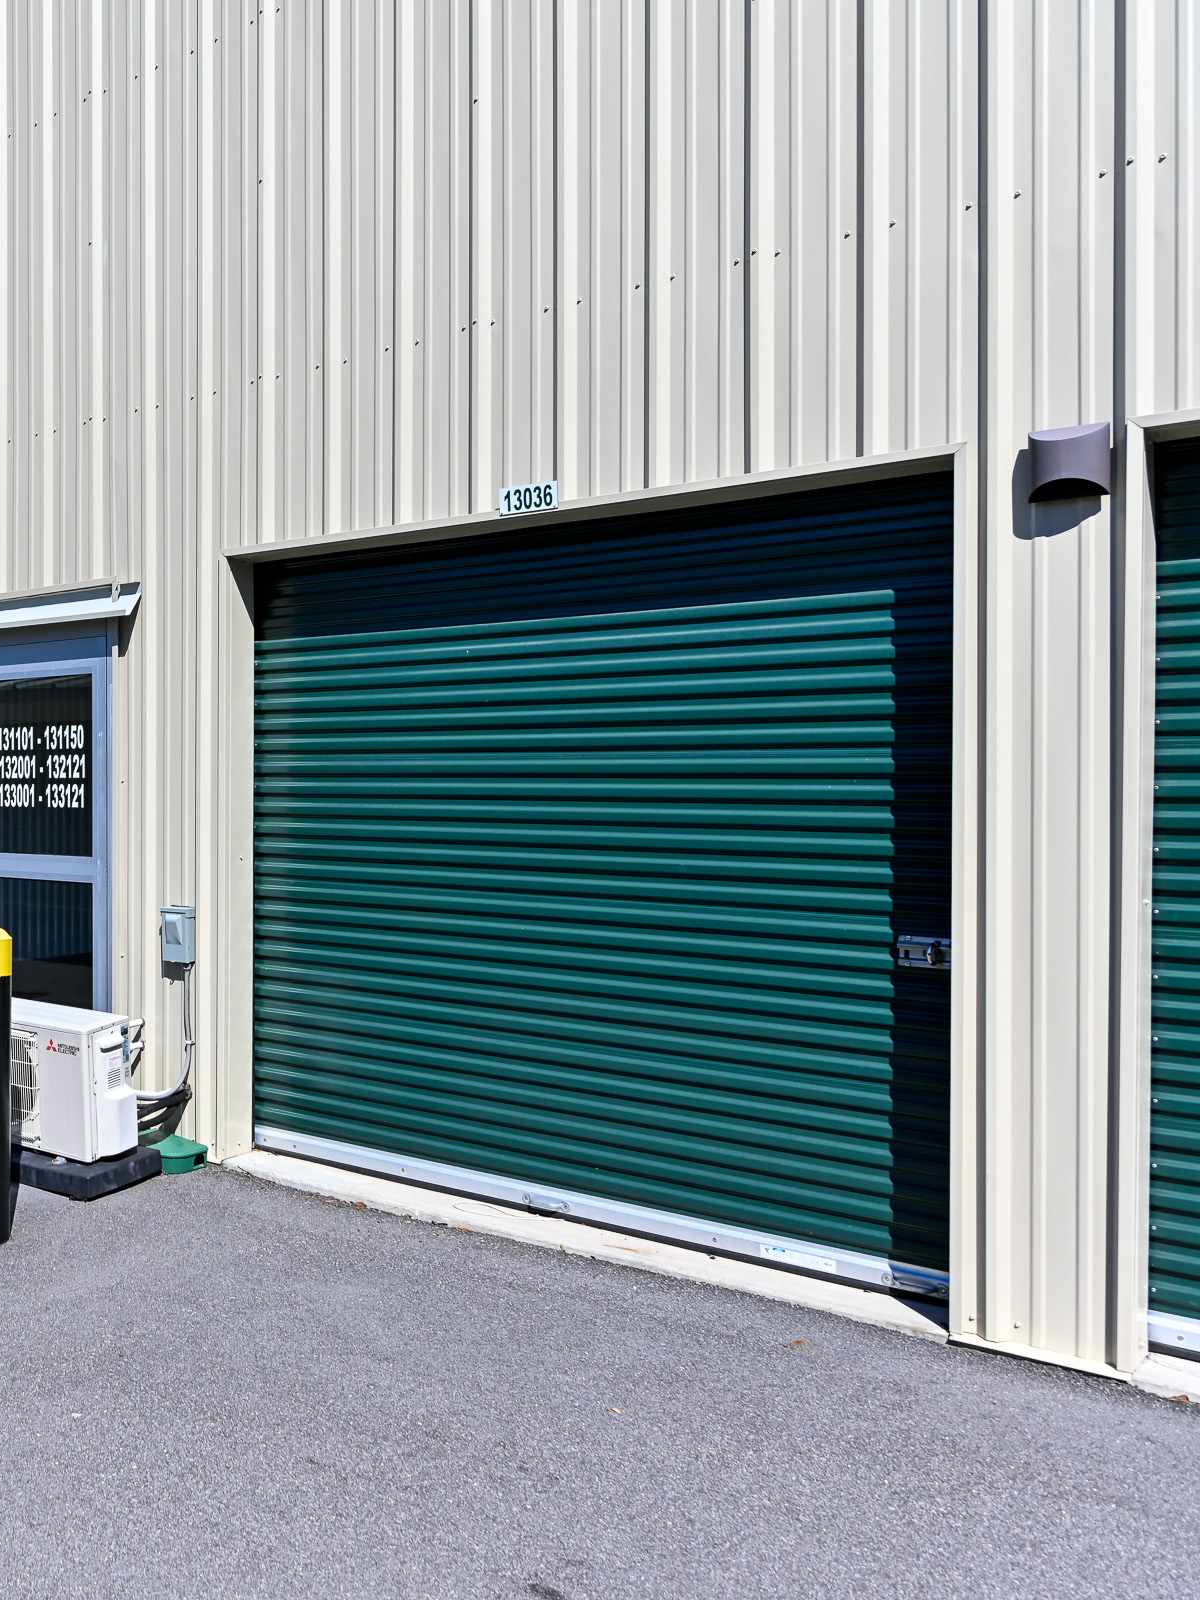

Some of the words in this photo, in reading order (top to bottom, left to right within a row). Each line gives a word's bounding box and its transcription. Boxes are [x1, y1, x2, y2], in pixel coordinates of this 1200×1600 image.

[504, 484, 553, 512] 13036
[44, 724, 85, 750] 131150
[0, 755, 36, 779] 132001
[46, 754, 86, 779] 132121
[45, 783, 85, 808] 133121
